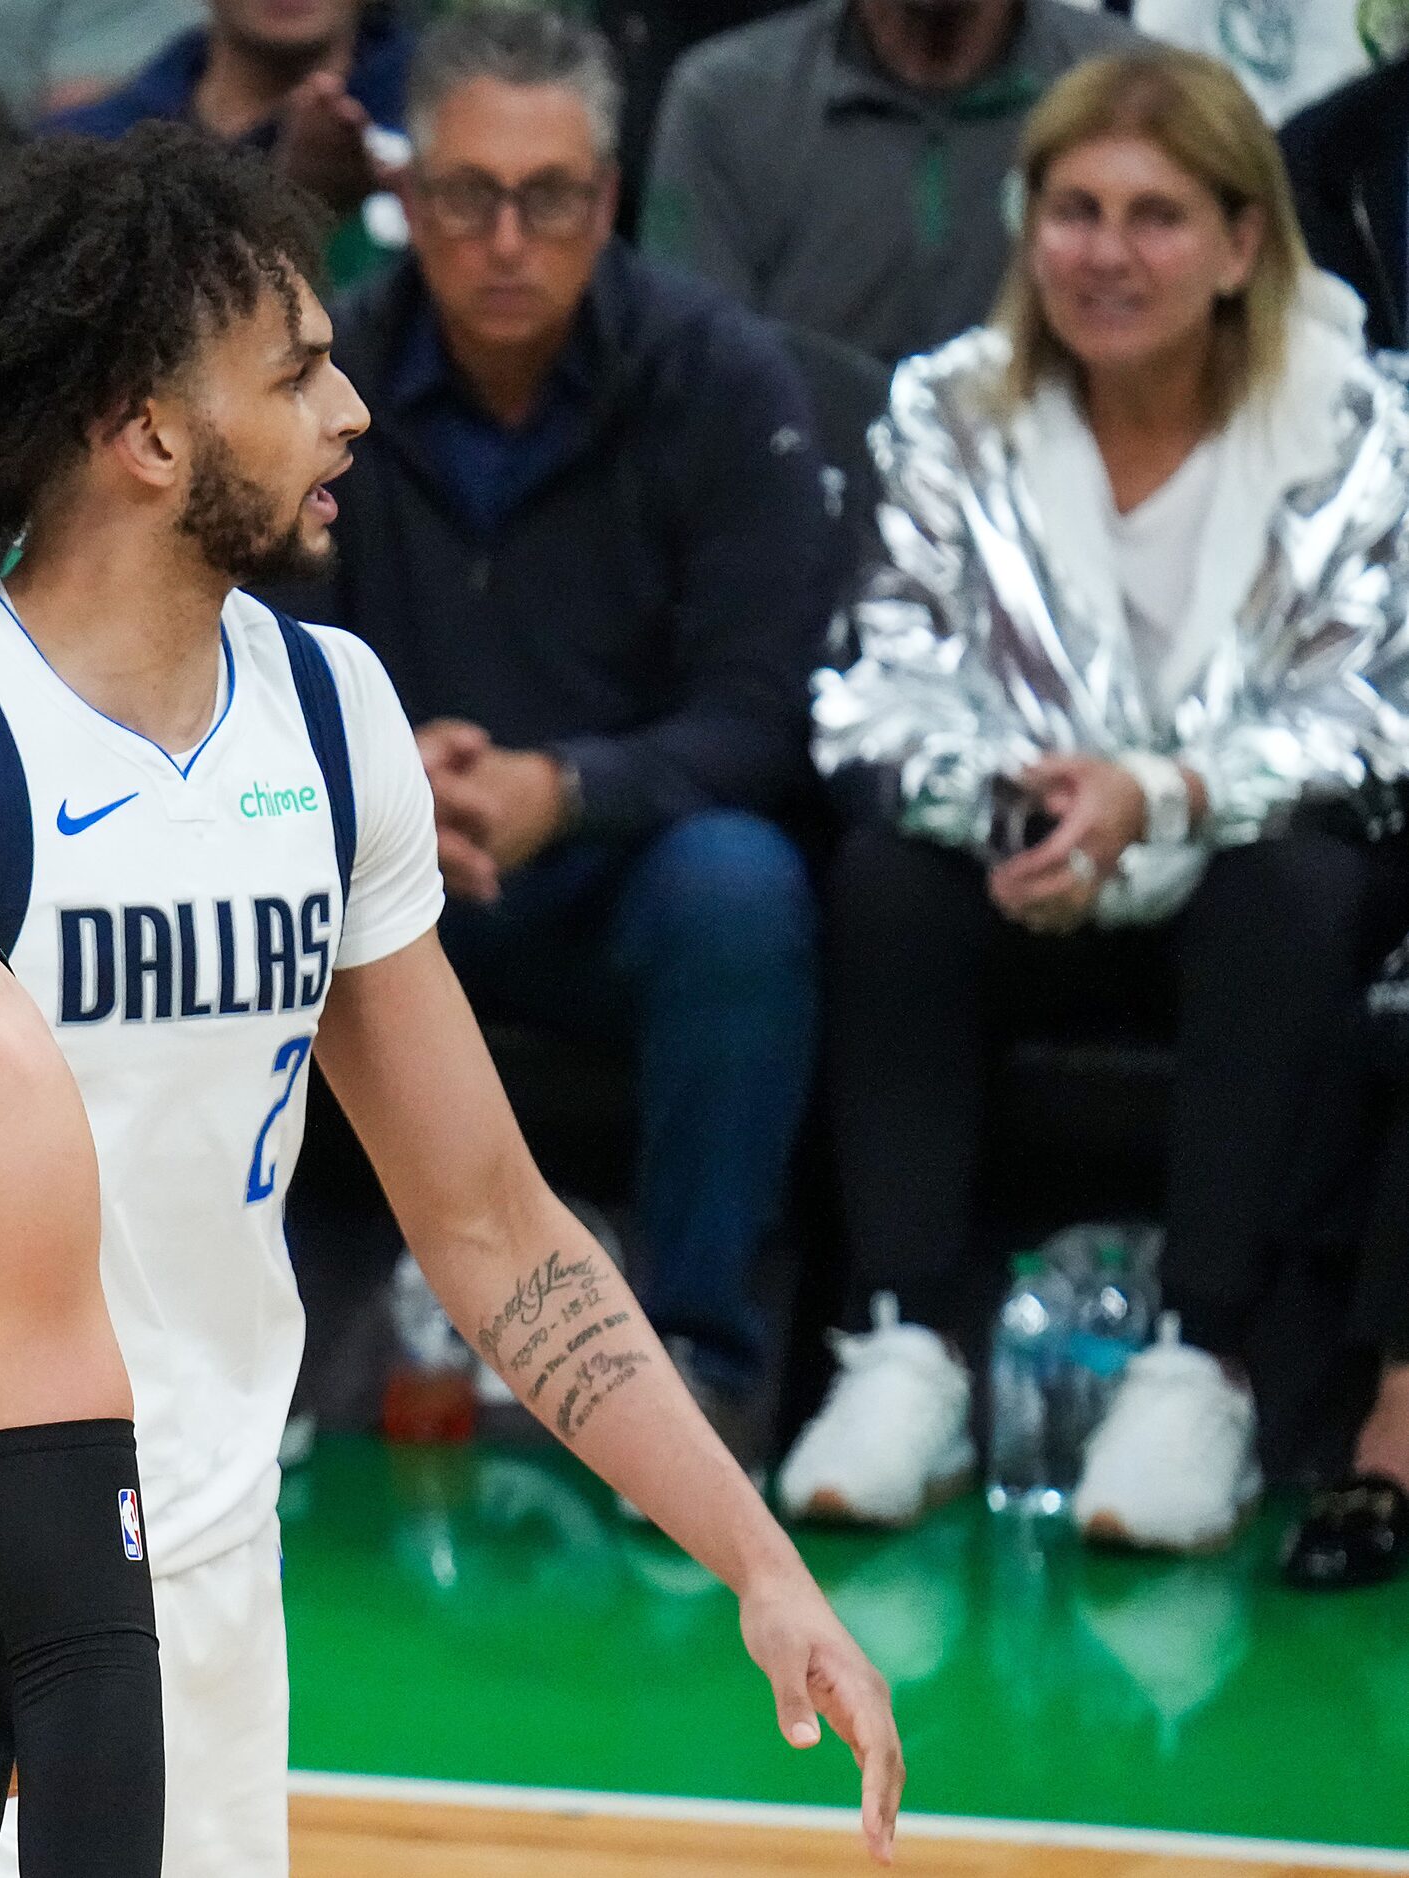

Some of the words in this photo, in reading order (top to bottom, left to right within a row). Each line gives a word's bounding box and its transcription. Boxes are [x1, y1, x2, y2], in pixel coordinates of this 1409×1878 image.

[240, 781, 318, 818] chime
[56, 890, 332, 1027] DALLAS
[243, 1034, 313, 1208] 2
